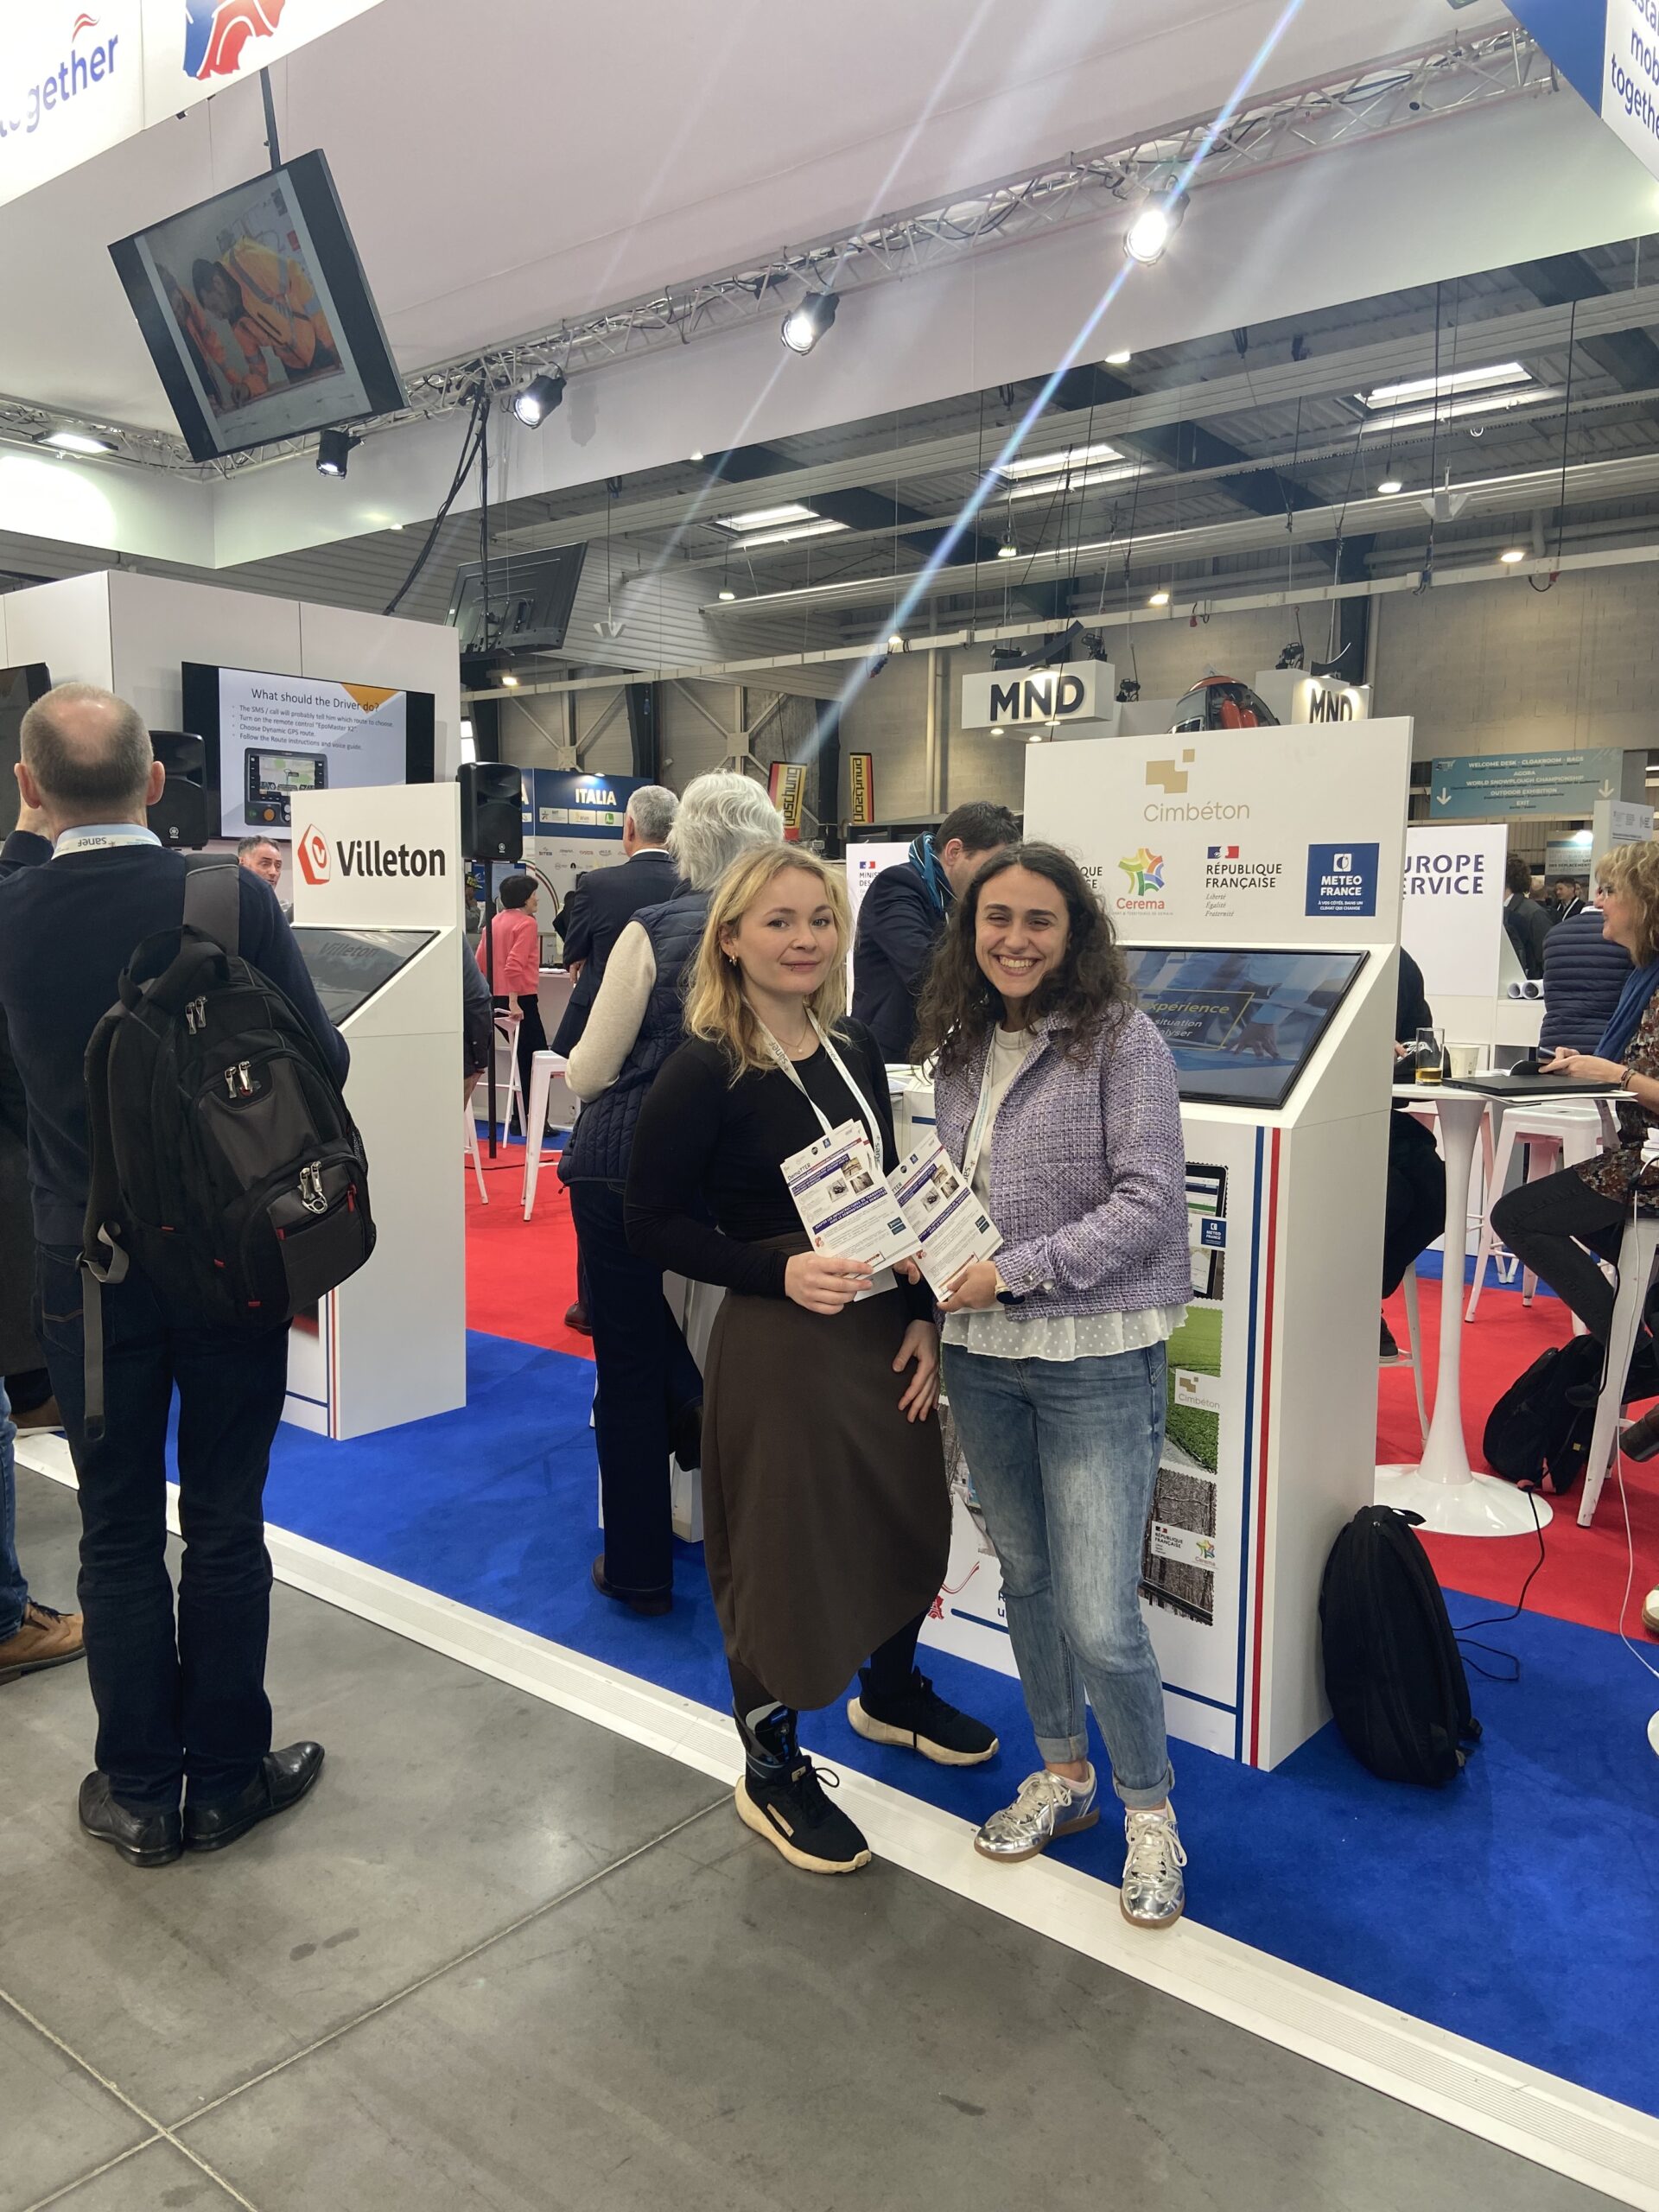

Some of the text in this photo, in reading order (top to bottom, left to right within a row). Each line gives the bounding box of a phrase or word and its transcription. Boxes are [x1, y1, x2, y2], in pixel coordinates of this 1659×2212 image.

[0, 35, 118, 138] gether
[251, 689, 379, 712] What should the Driver do?
[990, 675, 1084, 721] MND
[1309, 688, 1352, 723] MND
[291, 710, 315, 719] probably
[262, 726, 286, 734] Dynamic
[575, 788, 617, 806] ITALIA
[1144, 801, 1249, 823] Cimbéton
[78, 836, 107, 847] sanef
[336, 841, 446, 877] Villeton
[1206, 861, 1282, 876] RÉPUBLIQUE
[1205, 877, 1276, 889] FRANÇAISE
[1321, 875, 1363, 886] METEO
[1320, 887, 1362, 896] FRANCE
[1116, 898, 1165, 910] Cerema
[1179, 1393, 1220, 1408] Cimbéton
